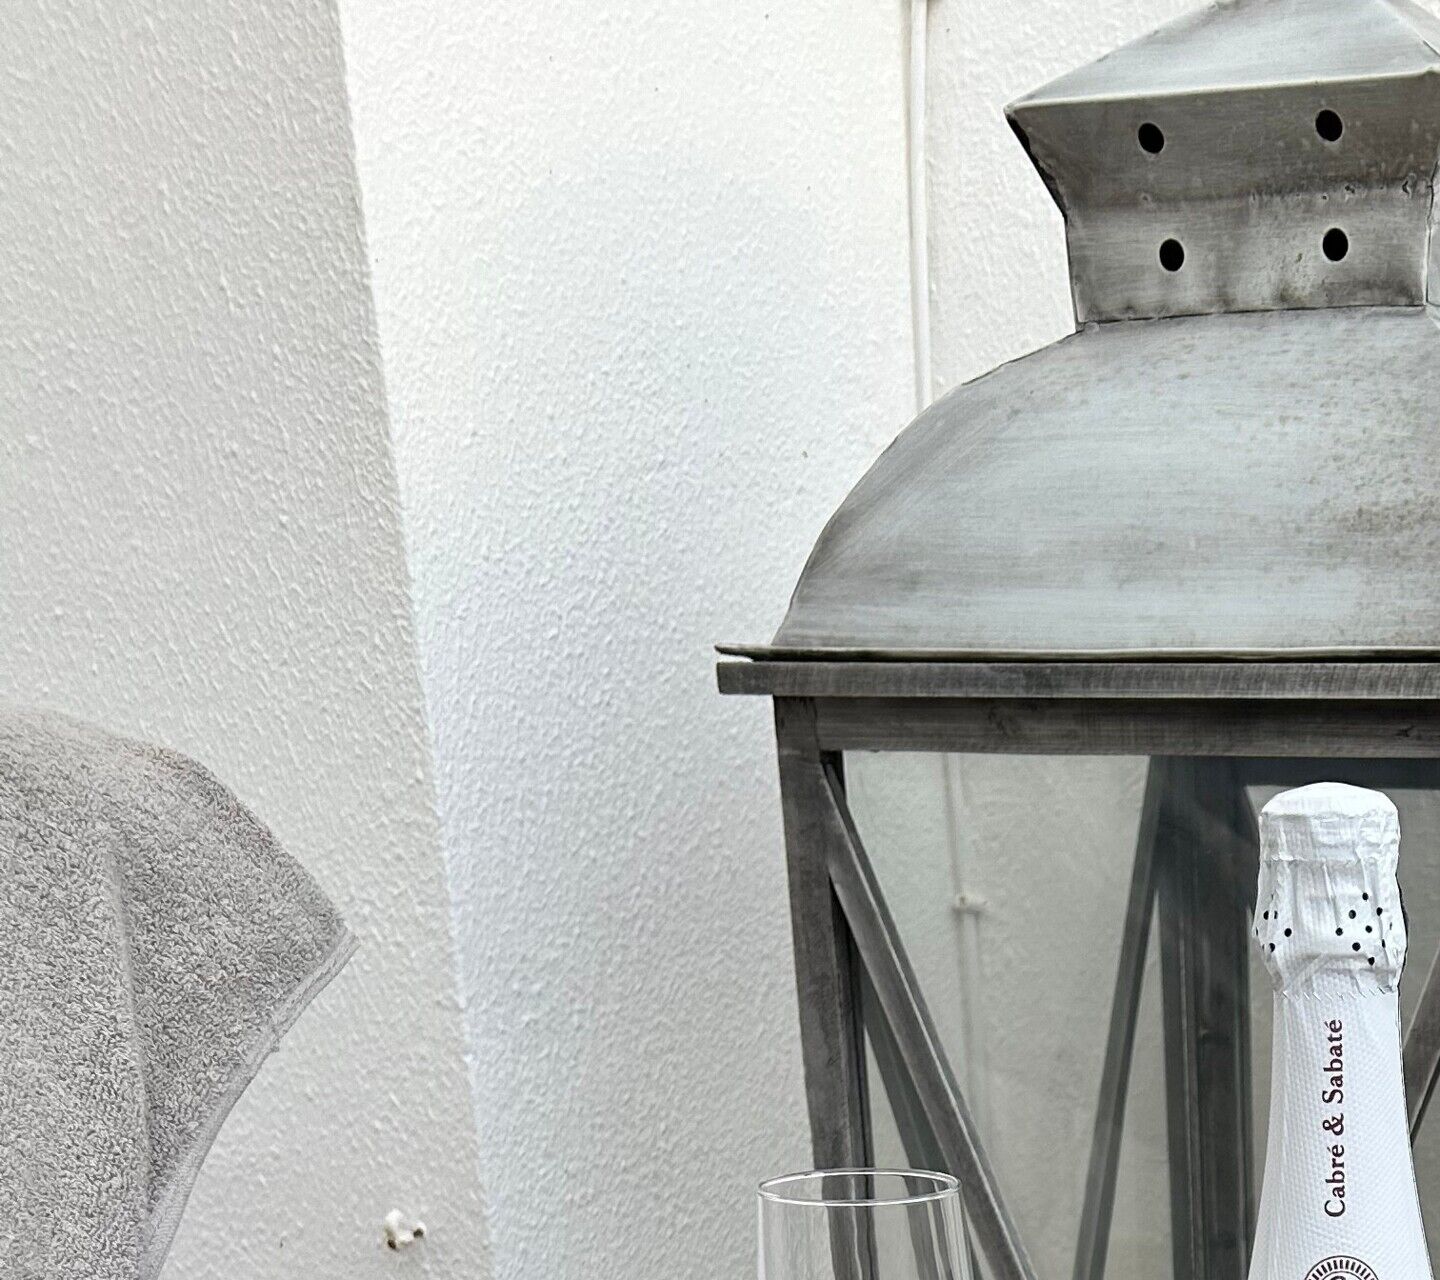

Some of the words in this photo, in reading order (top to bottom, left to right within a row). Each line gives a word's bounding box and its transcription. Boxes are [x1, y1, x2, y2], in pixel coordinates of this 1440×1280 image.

[1322, 1019, 1344, 1104] Sabaté
[1322, 1113, 1345, 1137] &
[1324, 1144, 1345, 1218] Cabré
